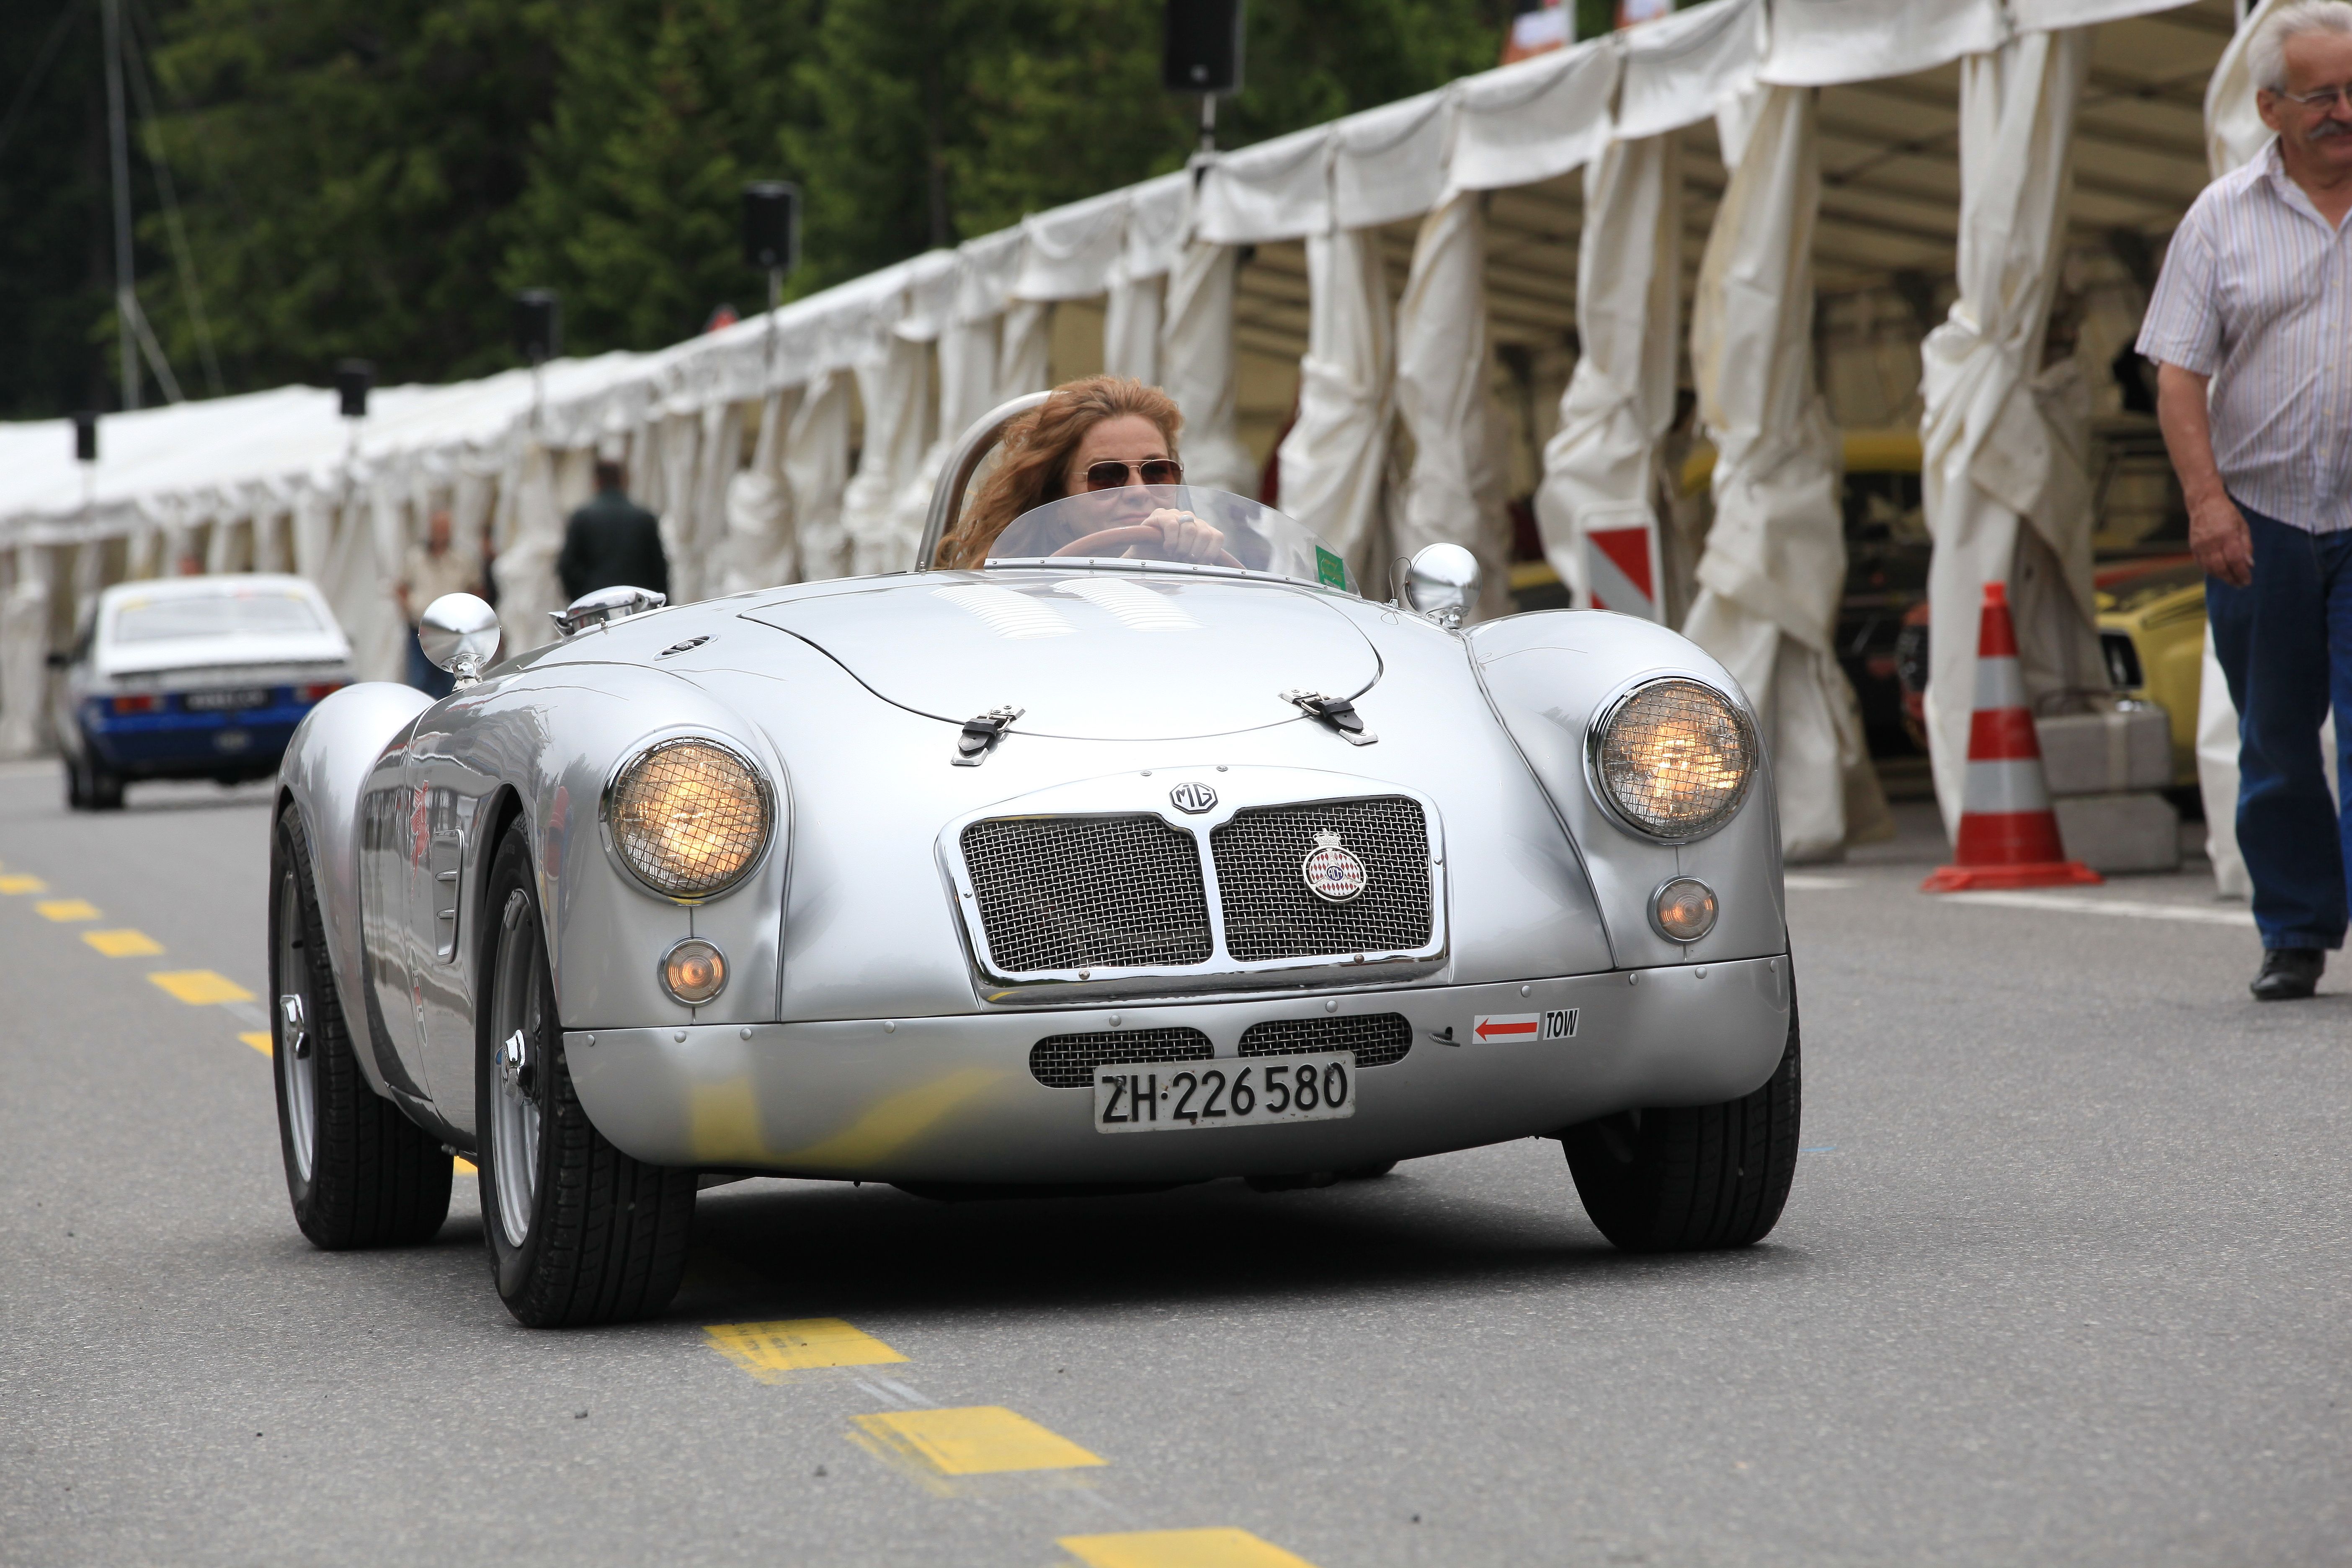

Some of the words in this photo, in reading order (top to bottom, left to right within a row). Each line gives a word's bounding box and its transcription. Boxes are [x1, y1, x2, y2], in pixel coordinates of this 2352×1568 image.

[1176, 784, 1212, 807] MG
[1328, 867, 1343, 880] ACM
[1547, 1010, 1578, 1038] TOW
